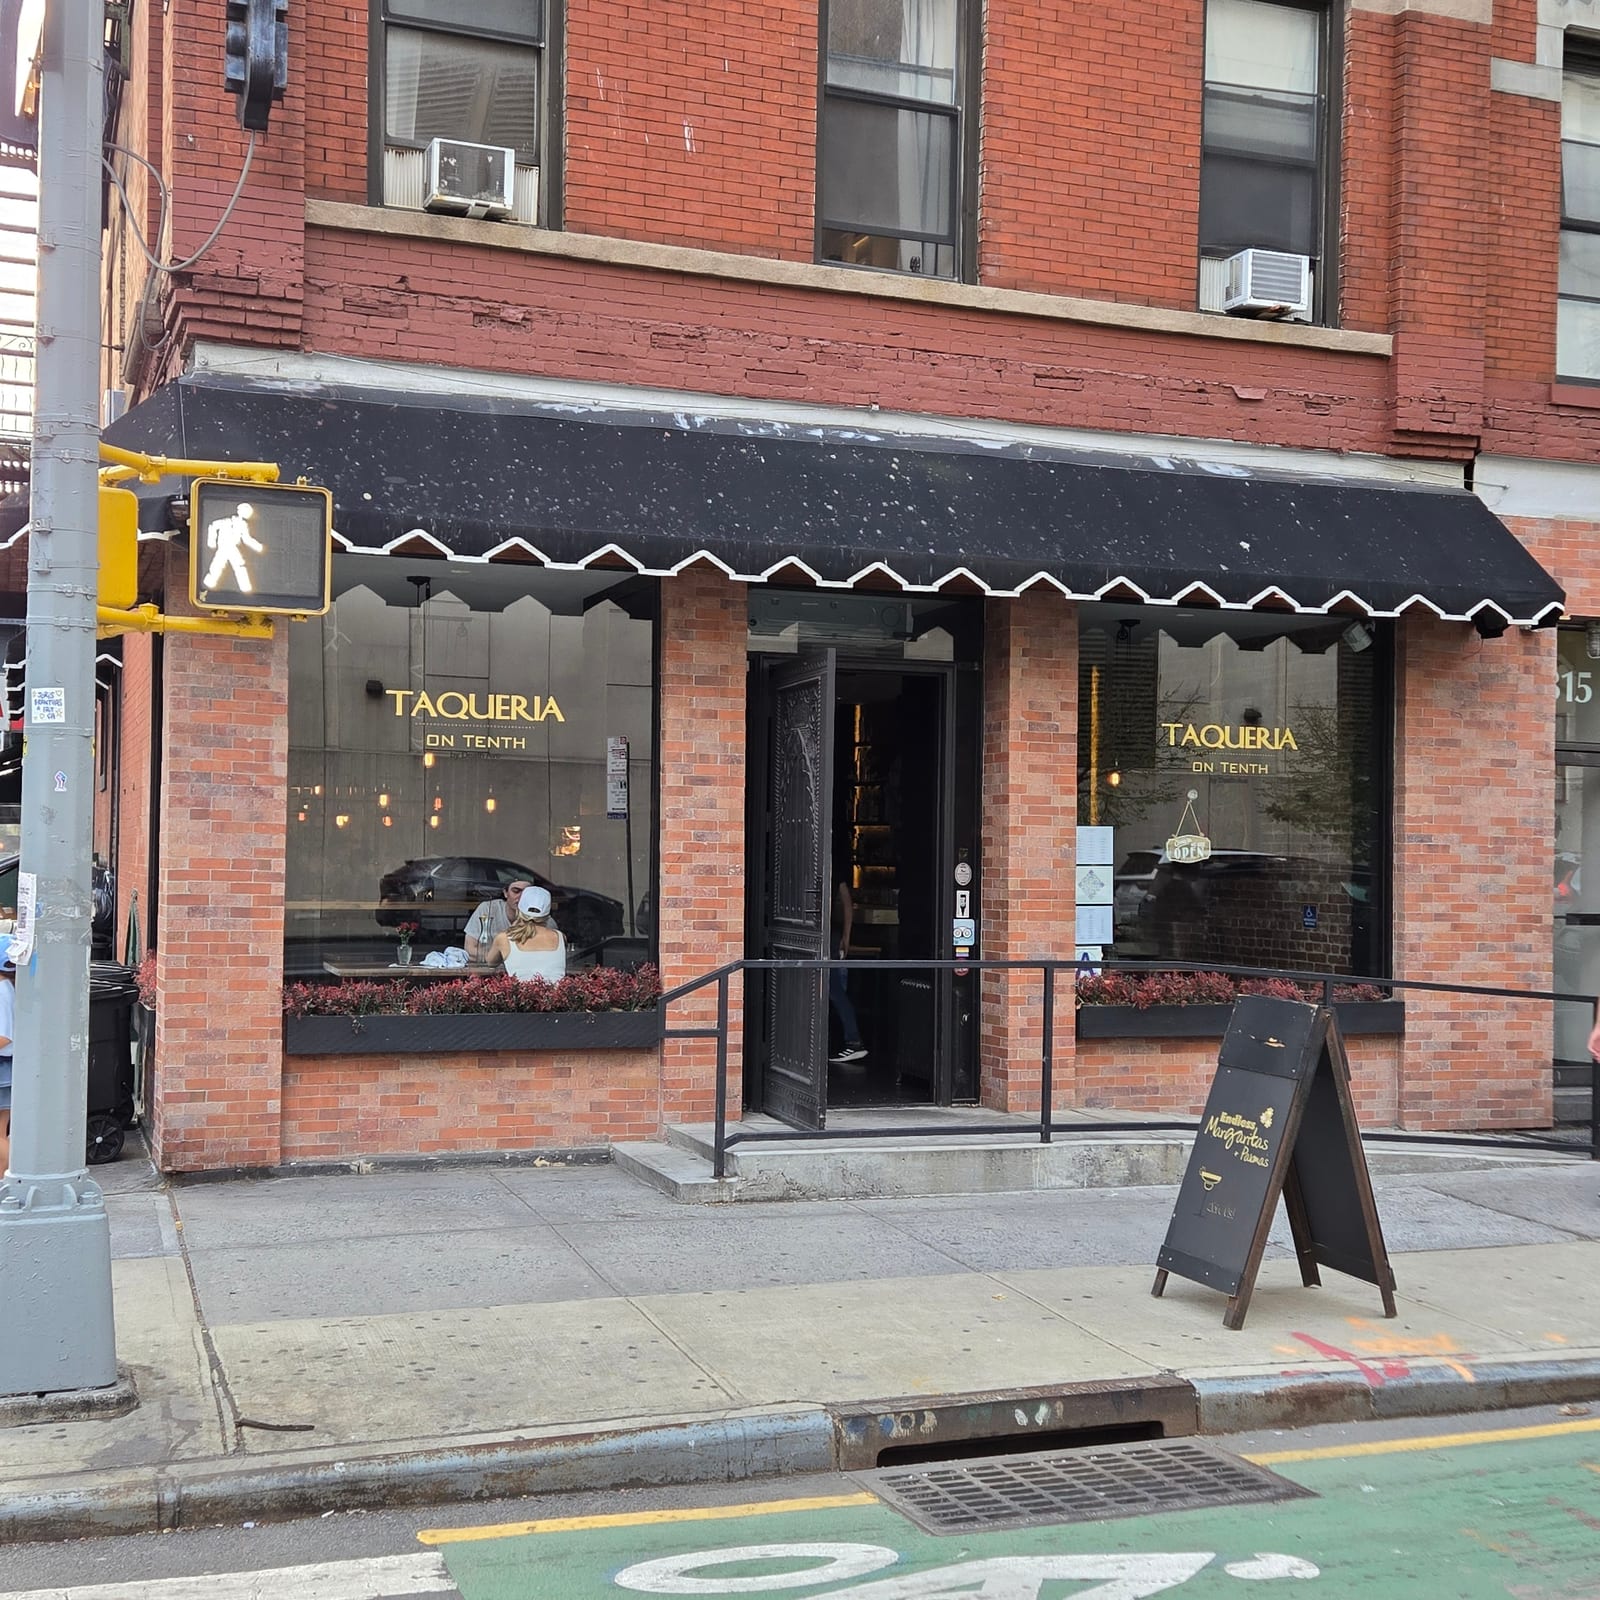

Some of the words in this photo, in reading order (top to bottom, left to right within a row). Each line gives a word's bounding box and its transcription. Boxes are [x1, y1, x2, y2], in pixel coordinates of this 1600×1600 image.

[385, 689, 566, 723] TAQUERIA
[426, 734, 455, 748] ON
[462, 734, 526, 750] TENTH
[1161, 723, 1298, 751] TAQUERIA
[1192, 761, 1214, 773] ON
[1220, 761, 1269, 775] TENTH
[1174, 845, 1205, 859] OPEN
[1220, 1111, 1257, 1130] Endless
[1204, 1115, 1269, 1151] Margaritas
